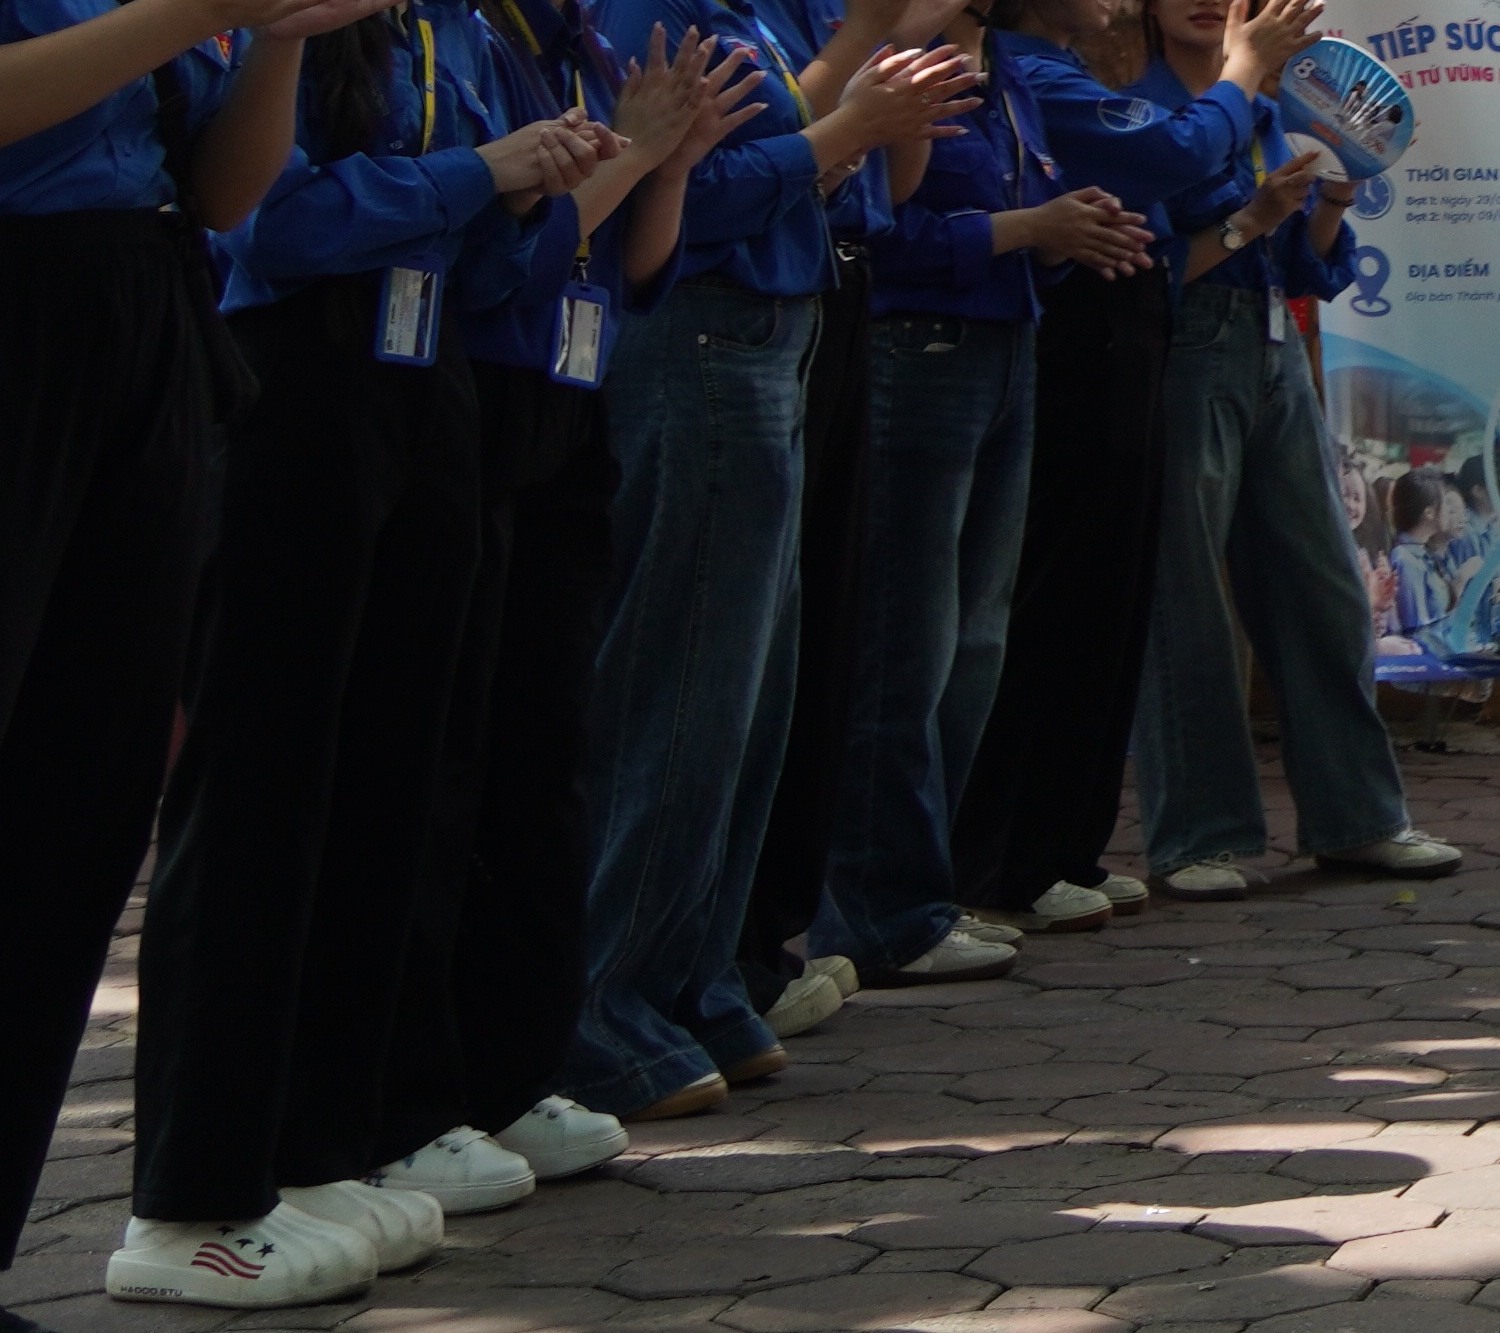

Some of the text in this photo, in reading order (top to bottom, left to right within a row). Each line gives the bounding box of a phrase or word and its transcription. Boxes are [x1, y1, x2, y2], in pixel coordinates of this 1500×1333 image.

[1367, 16, 1436, 62] TIẾP
[1405, 165, 1499, 182] THỜI GIAN
[1408, 264, 1439, 282] ĐỊA
